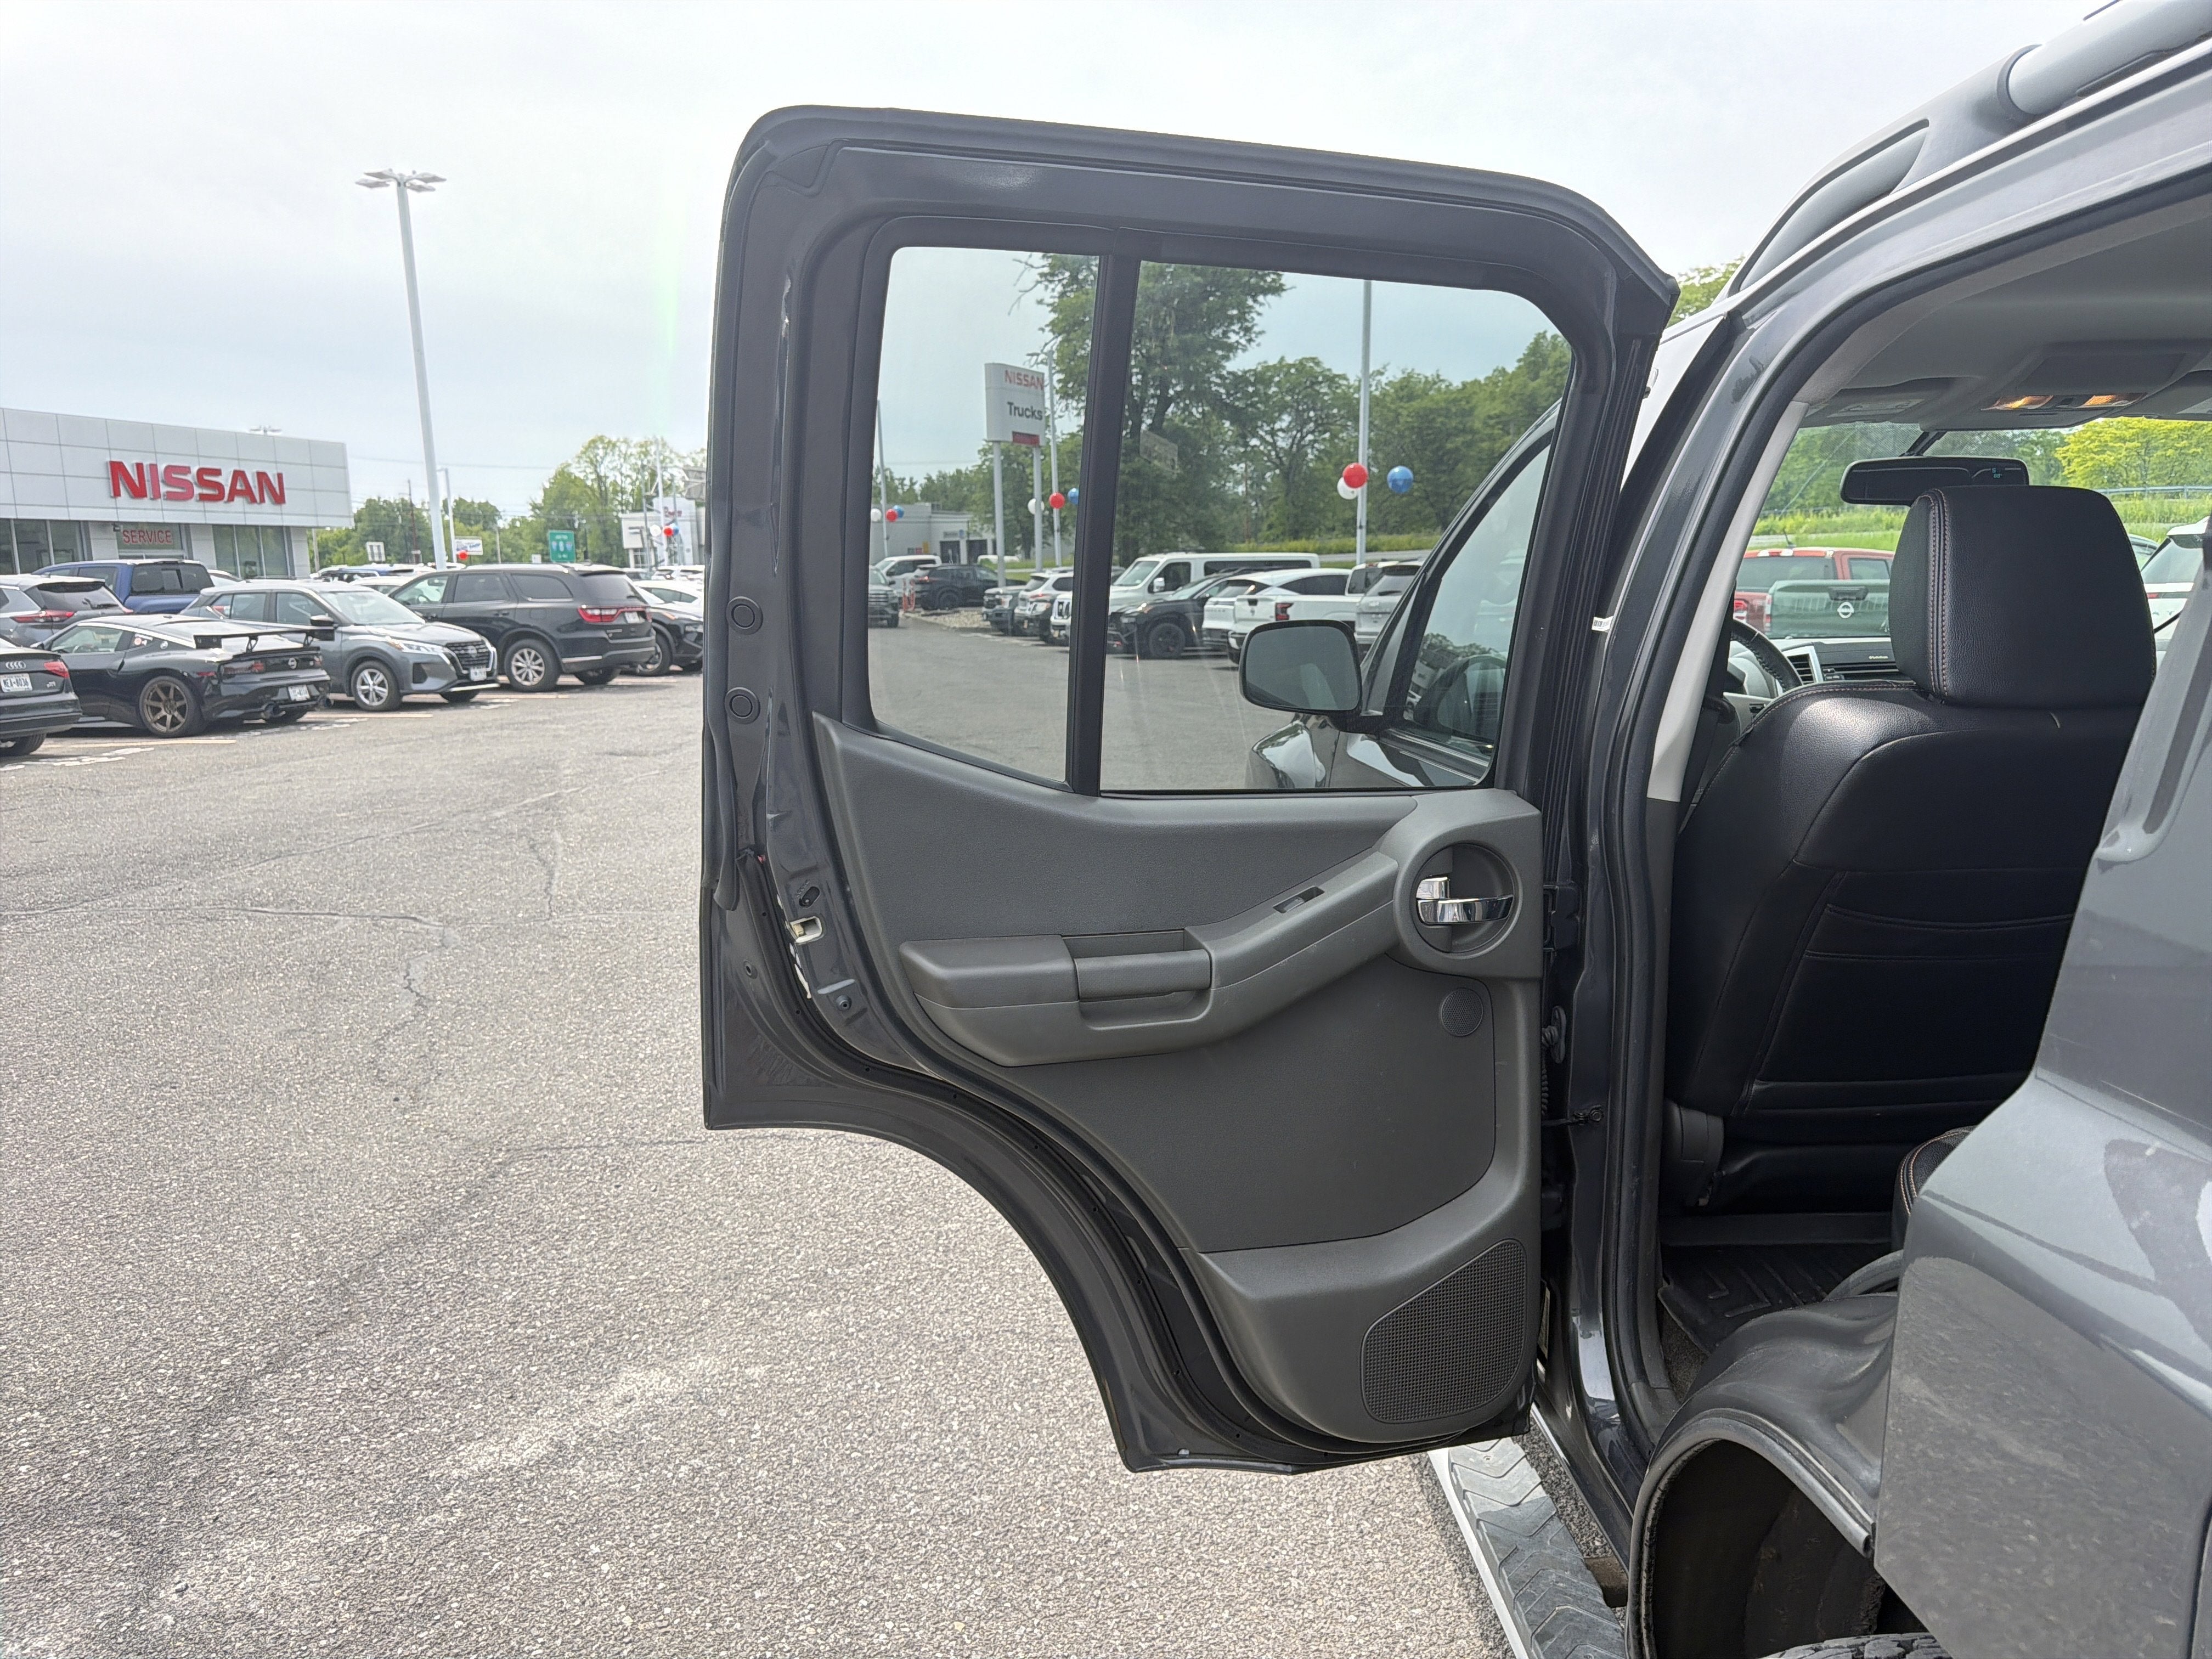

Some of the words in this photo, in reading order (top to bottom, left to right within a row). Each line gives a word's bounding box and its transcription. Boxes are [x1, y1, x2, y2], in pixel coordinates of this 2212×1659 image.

[1005, 369, 1044, 391] NISSAN
[1007, 402, 1043, 421] Trucks
[109, 460, 286, 505] NISSAN
[122, 529, 172, 544] SERVICE
